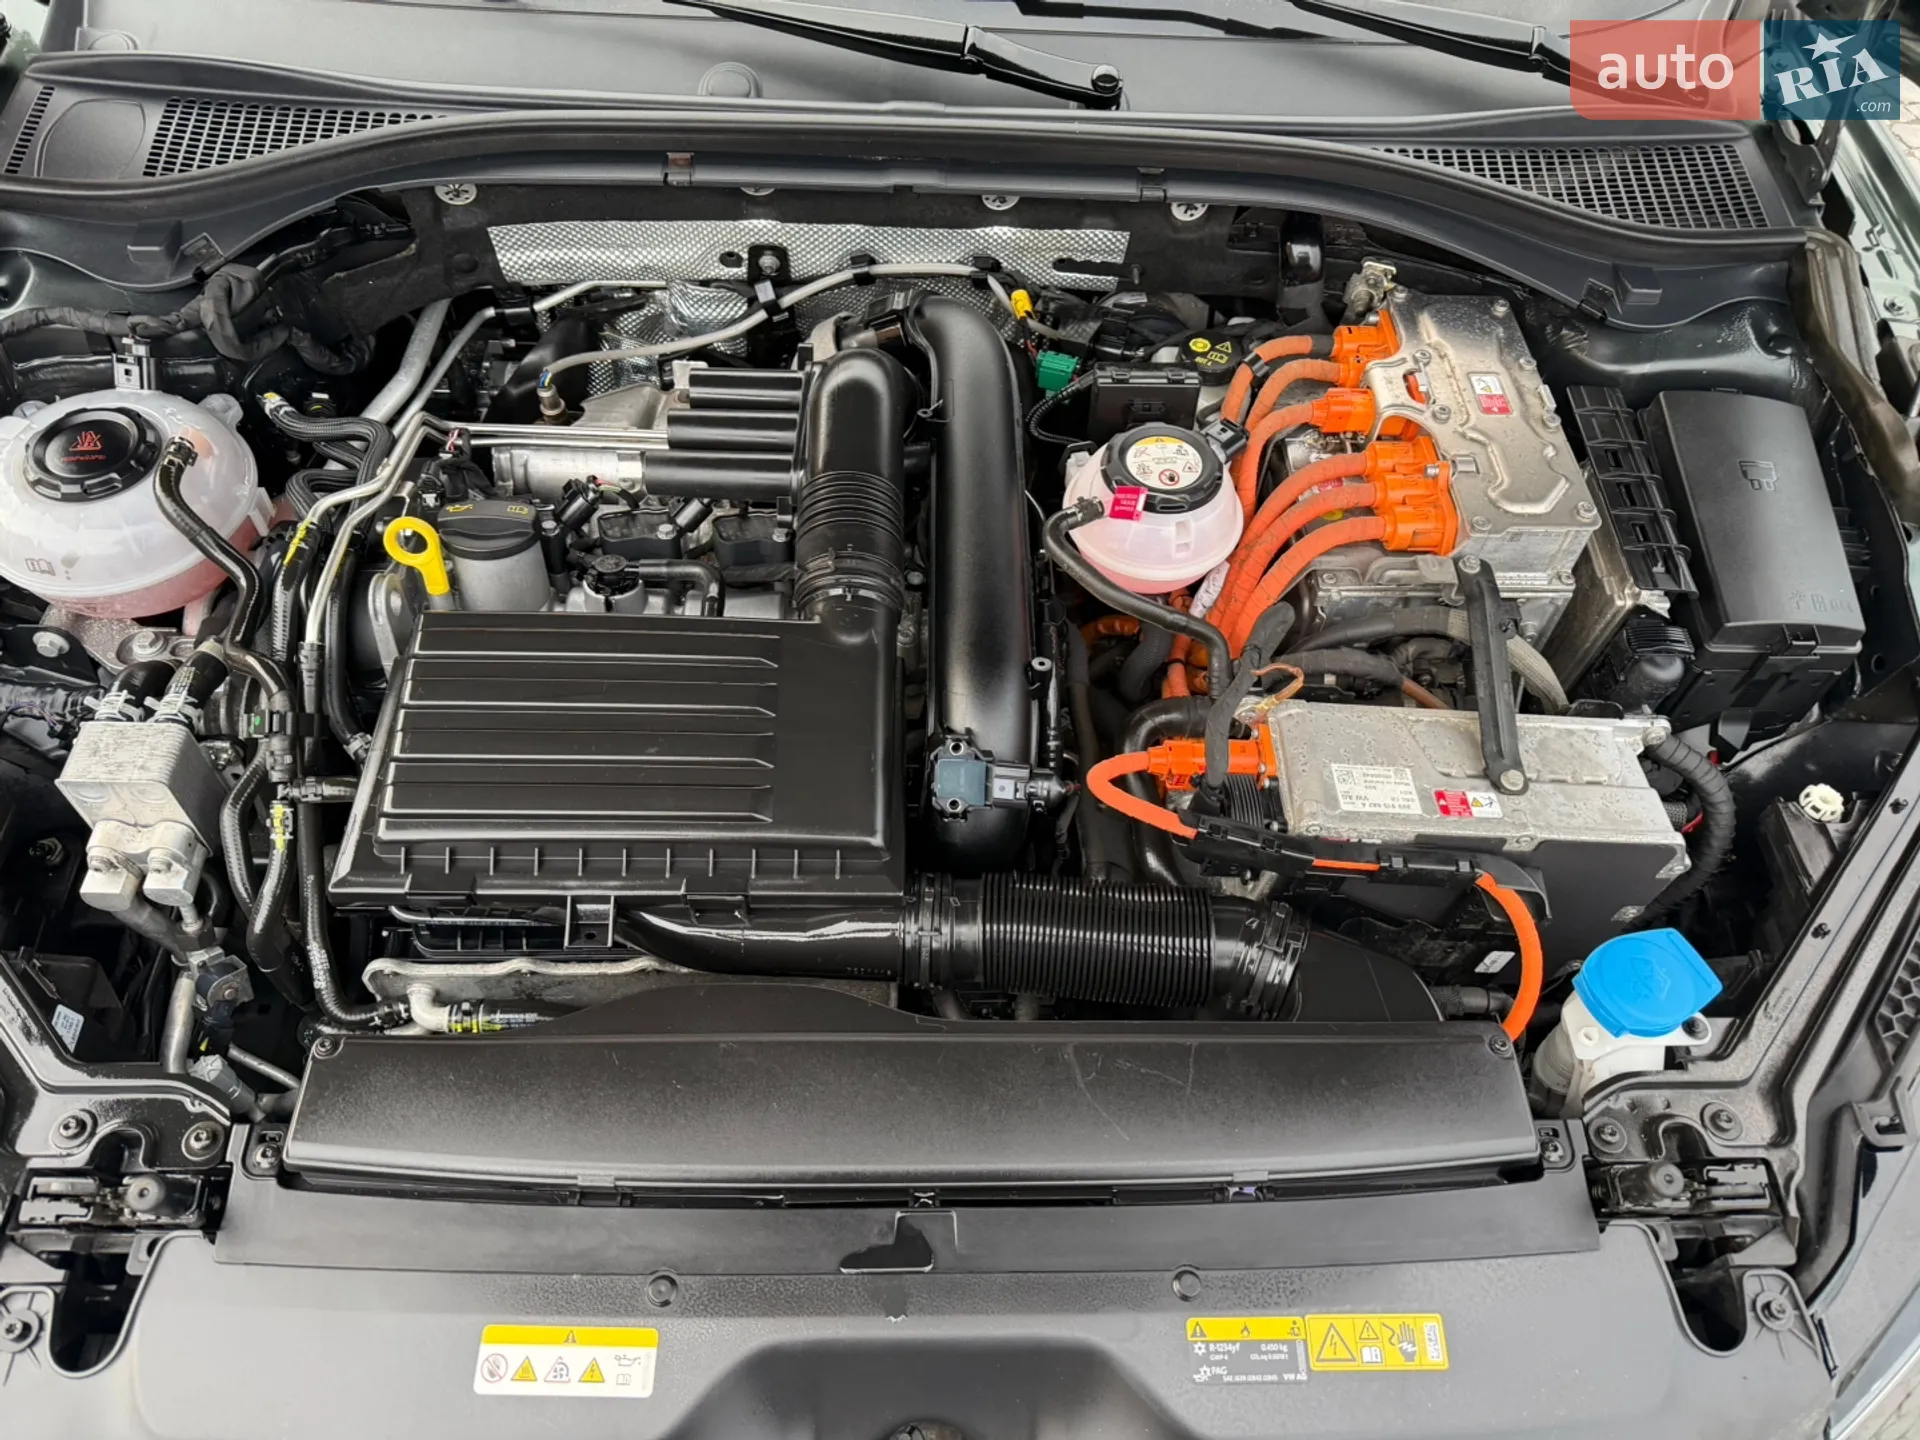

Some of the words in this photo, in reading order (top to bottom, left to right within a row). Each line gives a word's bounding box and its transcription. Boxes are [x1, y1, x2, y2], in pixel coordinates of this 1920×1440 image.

[1210, 1366, 1228, 1375] PAG
[1282, 1373, 1296, 1381] VW
[1296, 1373, 1308, 1381] AG
